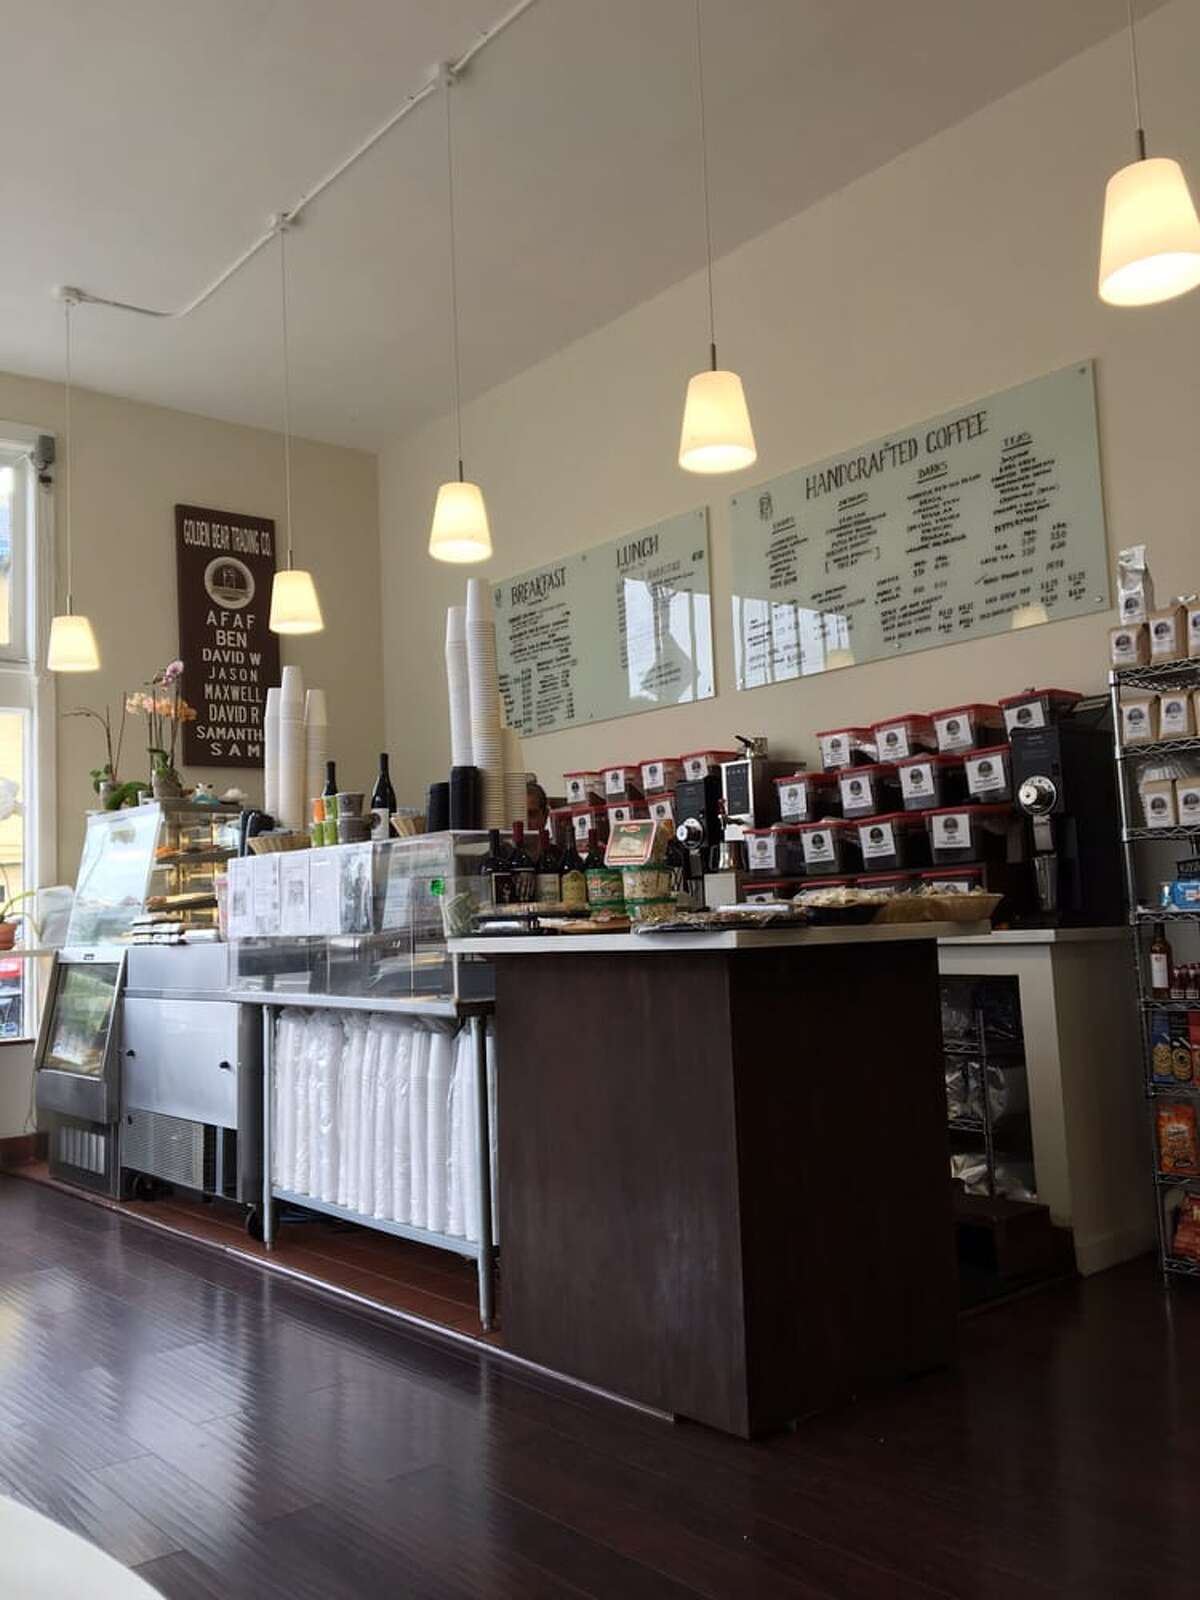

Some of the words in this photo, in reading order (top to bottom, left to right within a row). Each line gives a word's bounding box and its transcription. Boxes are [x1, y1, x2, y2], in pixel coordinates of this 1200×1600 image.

[806, 437, 918, 499] HANDCRAFTED
[926, 410, 989, 453] COFFEE
[184, 519, 211, 547] GOLDEN
[212, 523, 230, 550] BEAR
[231, 526, 259, 554] TRADING
[617, 534, 659, 568] LUNCH
[511, 566, 567, 606] BREAKFAST
[206, 610, 256, 629] AFAF
[216, 629, 248, 648] BEN
[202, 648, 245, 664] DAVID
[250, 652, 262, 666] W
[209, 666, 258, 682] JASON
[204, 683, 263, 703] MAXWELL
[208, 703, 247, 723] DAVID
[251, 706, 260, 724] R
[196, 725, 264, 741] SAMANTH
[210, 743, 260, 757] SAM
